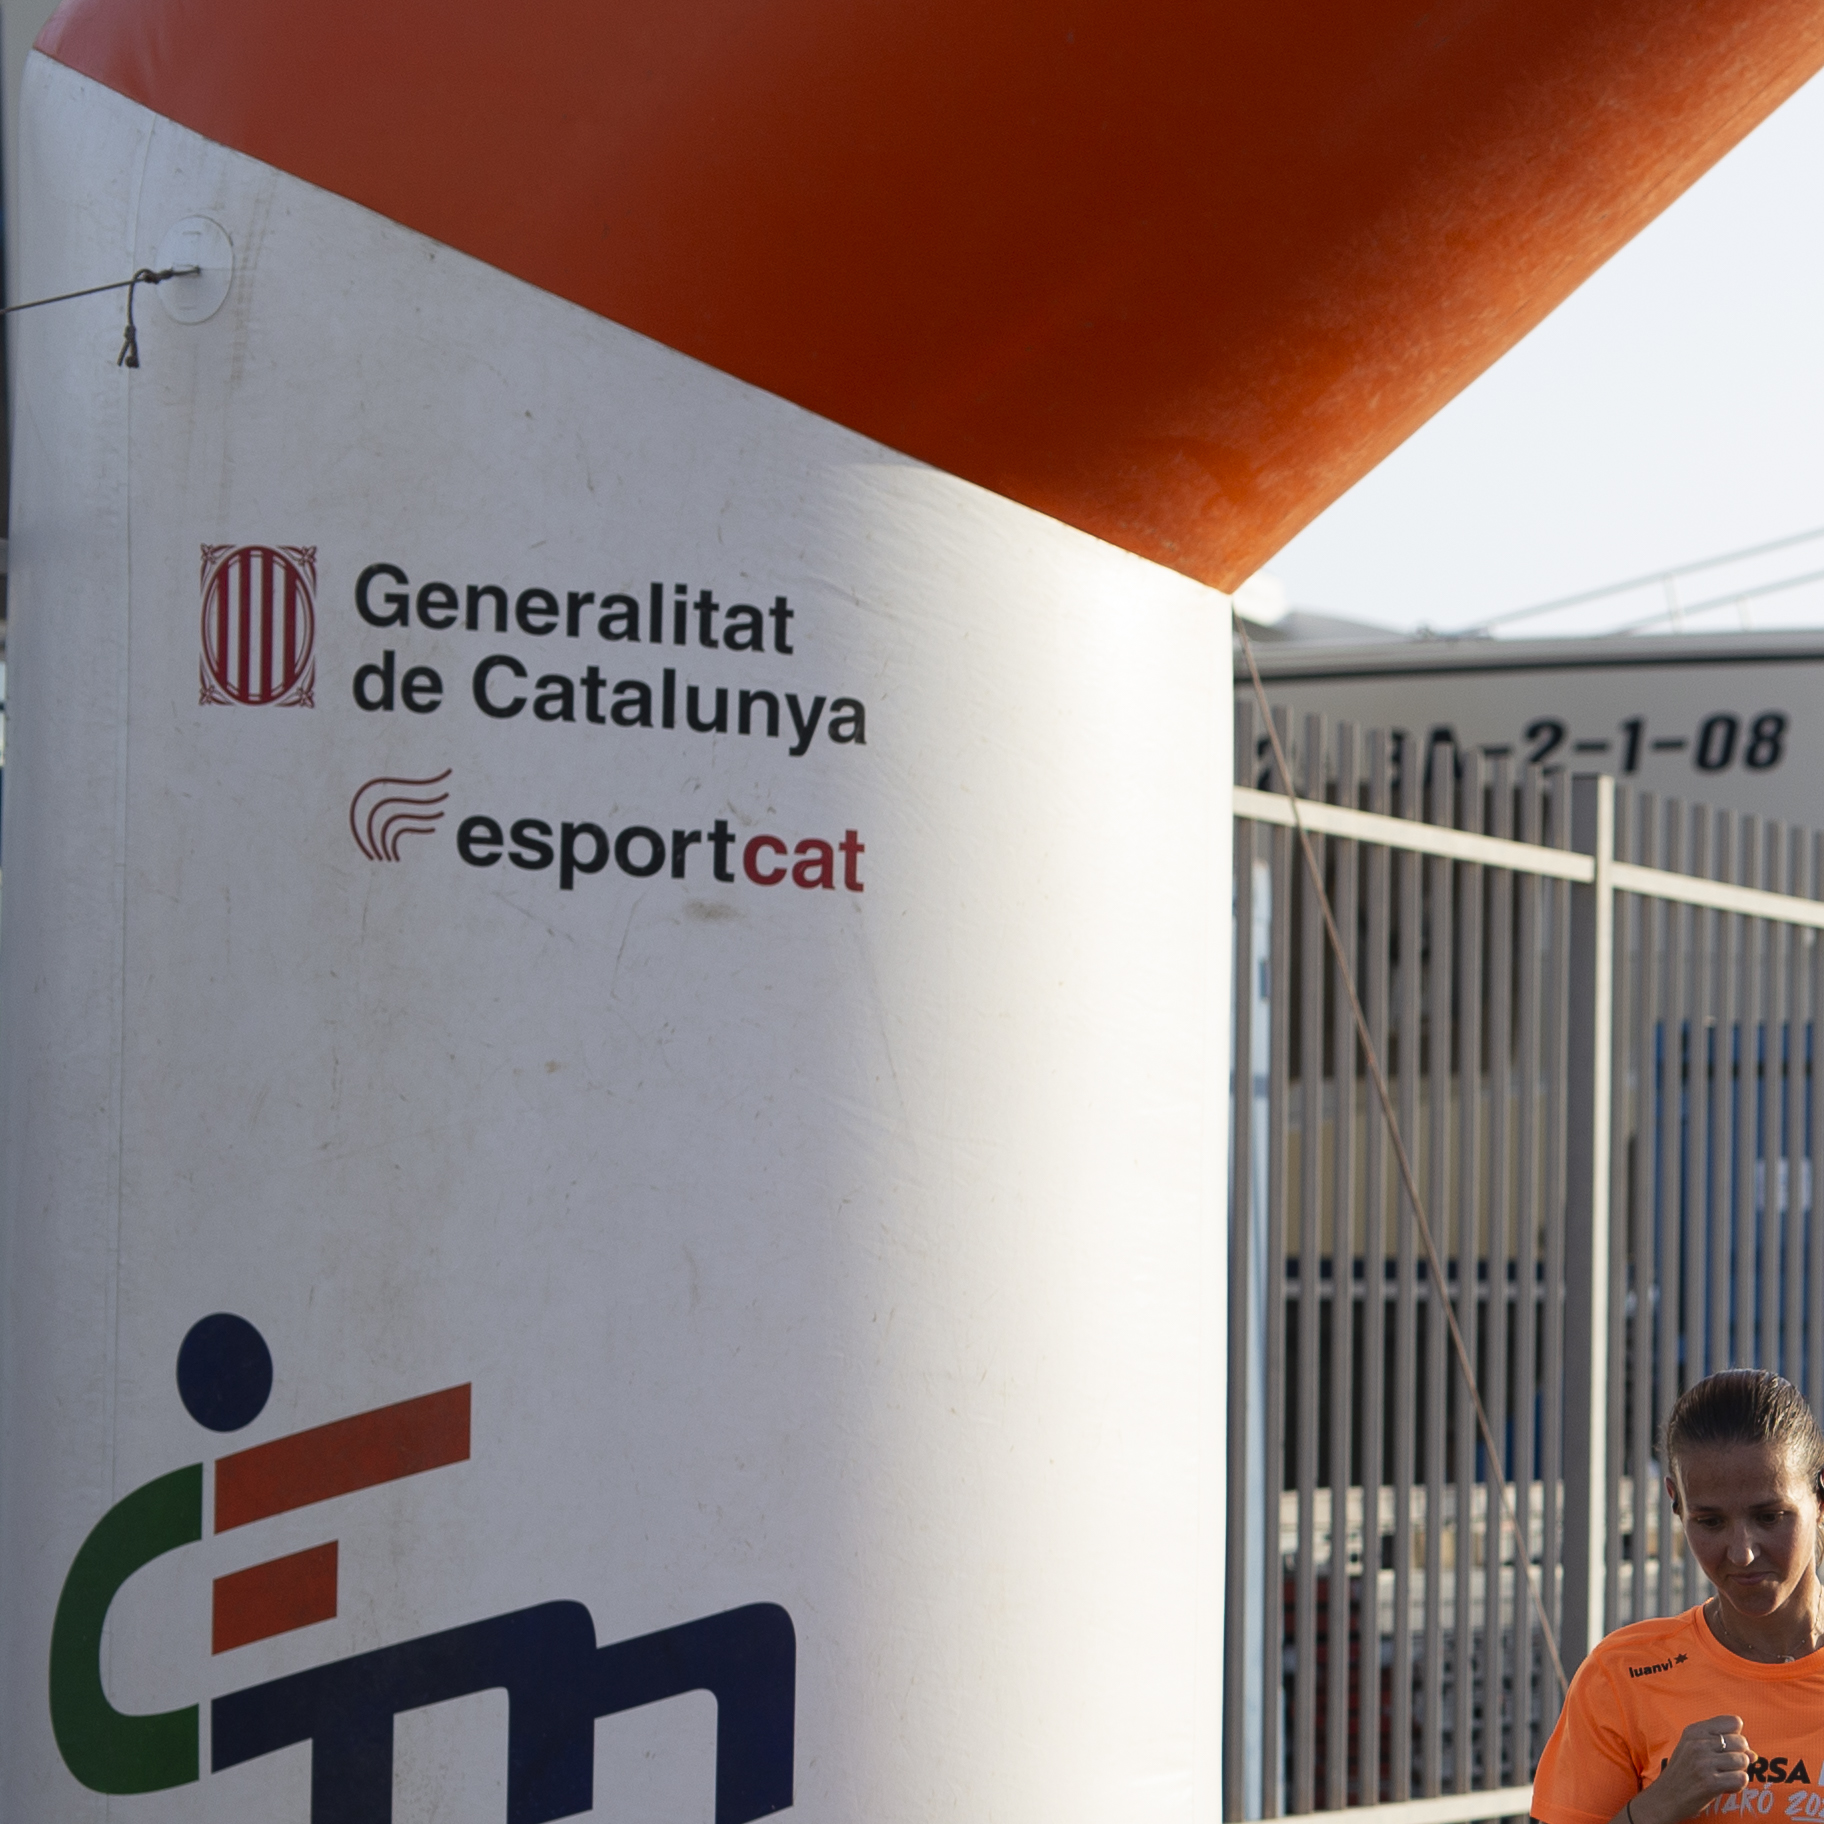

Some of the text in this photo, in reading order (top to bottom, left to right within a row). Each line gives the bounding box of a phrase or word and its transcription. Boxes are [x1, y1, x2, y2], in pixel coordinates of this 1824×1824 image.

[354, 562, 794, 655] Generalitat
[352, 649, 867, 757] de Catalunya
[455, 813, 866, 893] esportcat
[1629, 1658, 1673, 1678] luanvi
[1746, 1756, 1811, 1784] RSA
[1703, 1782, 1774, 1818] ARÓ
